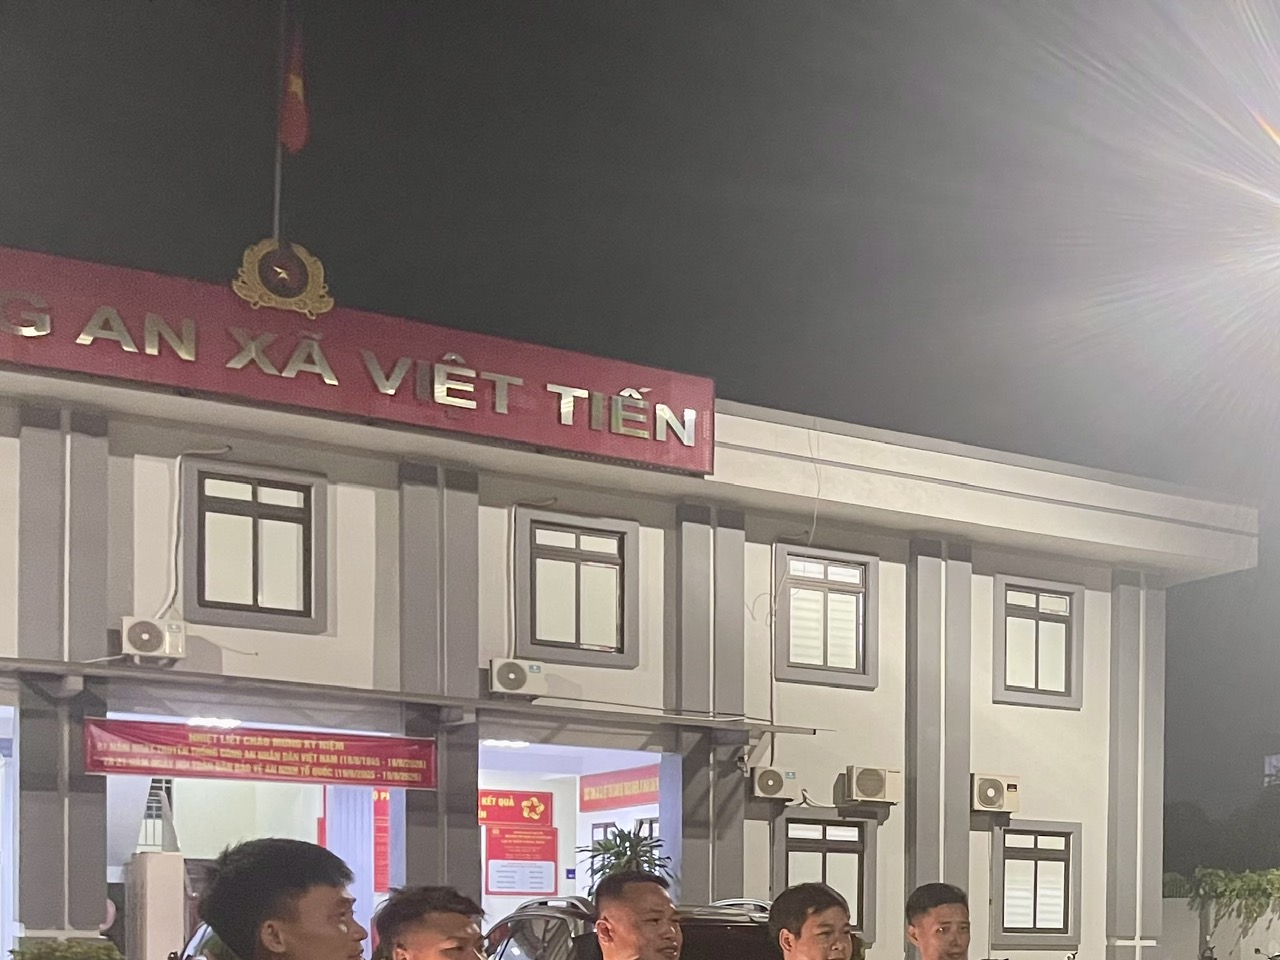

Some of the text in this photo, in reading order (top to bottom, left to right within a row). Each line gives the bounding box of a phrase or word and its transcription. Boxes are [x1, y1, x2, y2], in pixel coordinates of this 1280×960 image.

[75, 305, 197, 362] AN
[225, 325, 339, 386] XÃ
[546, 382, 697, 447] TIẾN
[481, 795, 497, 806] KẾT
